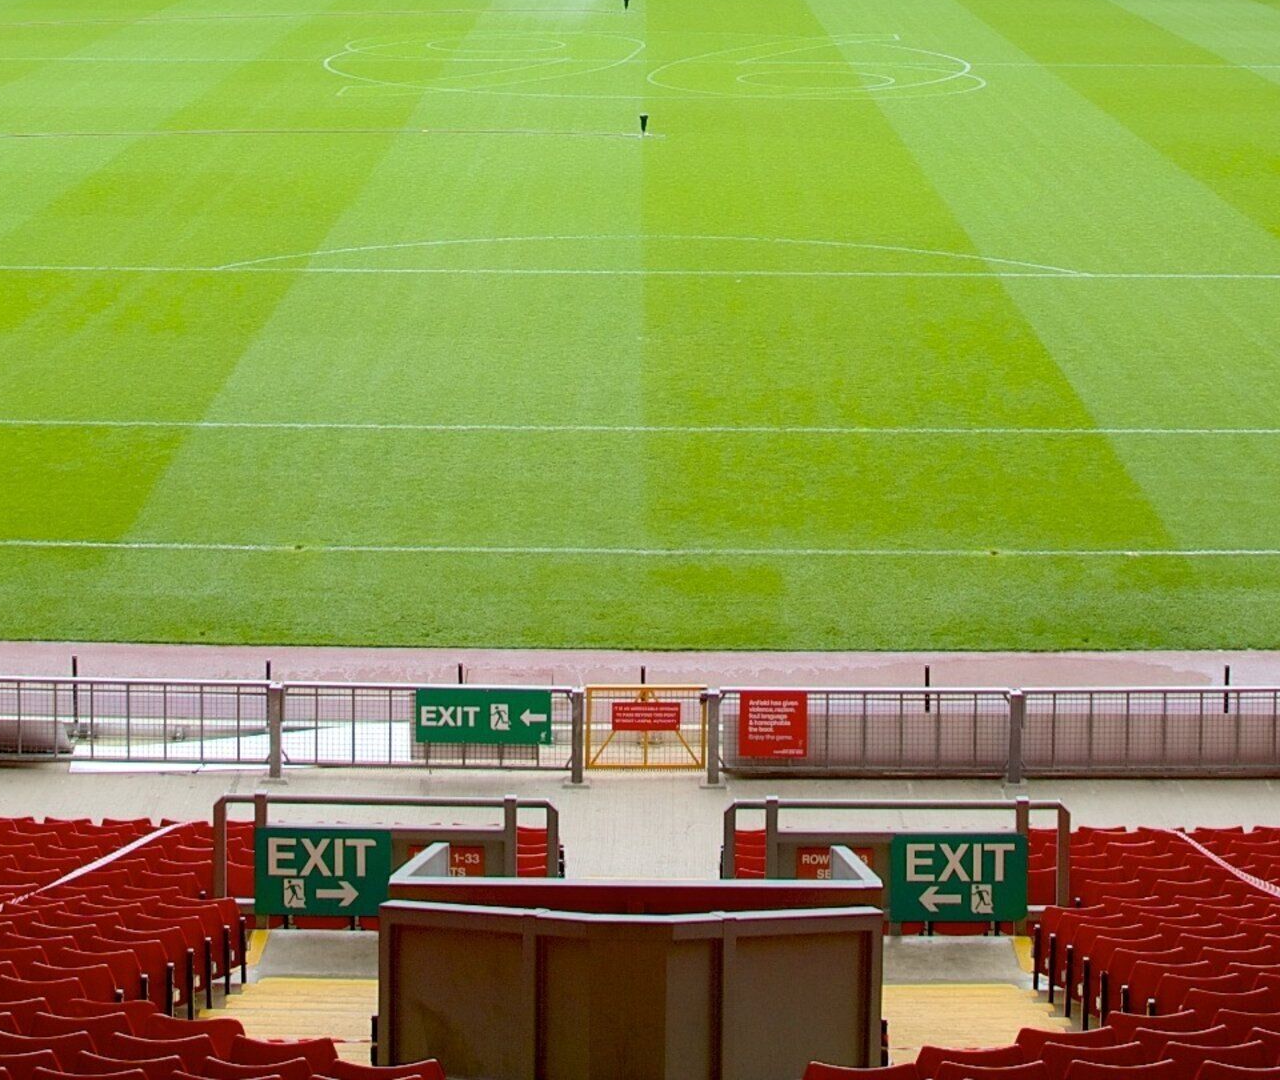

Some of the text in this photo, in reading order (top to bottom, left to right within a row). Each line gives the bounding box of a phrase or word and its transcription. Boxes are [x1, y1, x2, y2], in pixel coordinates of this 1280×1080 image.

[421, 706, 480, 727] EXIT
[268, 837, 376, 877] EXIT
[454, 854, 480, 864] 1-33
[906, 843, 1016, 882] EXIT
